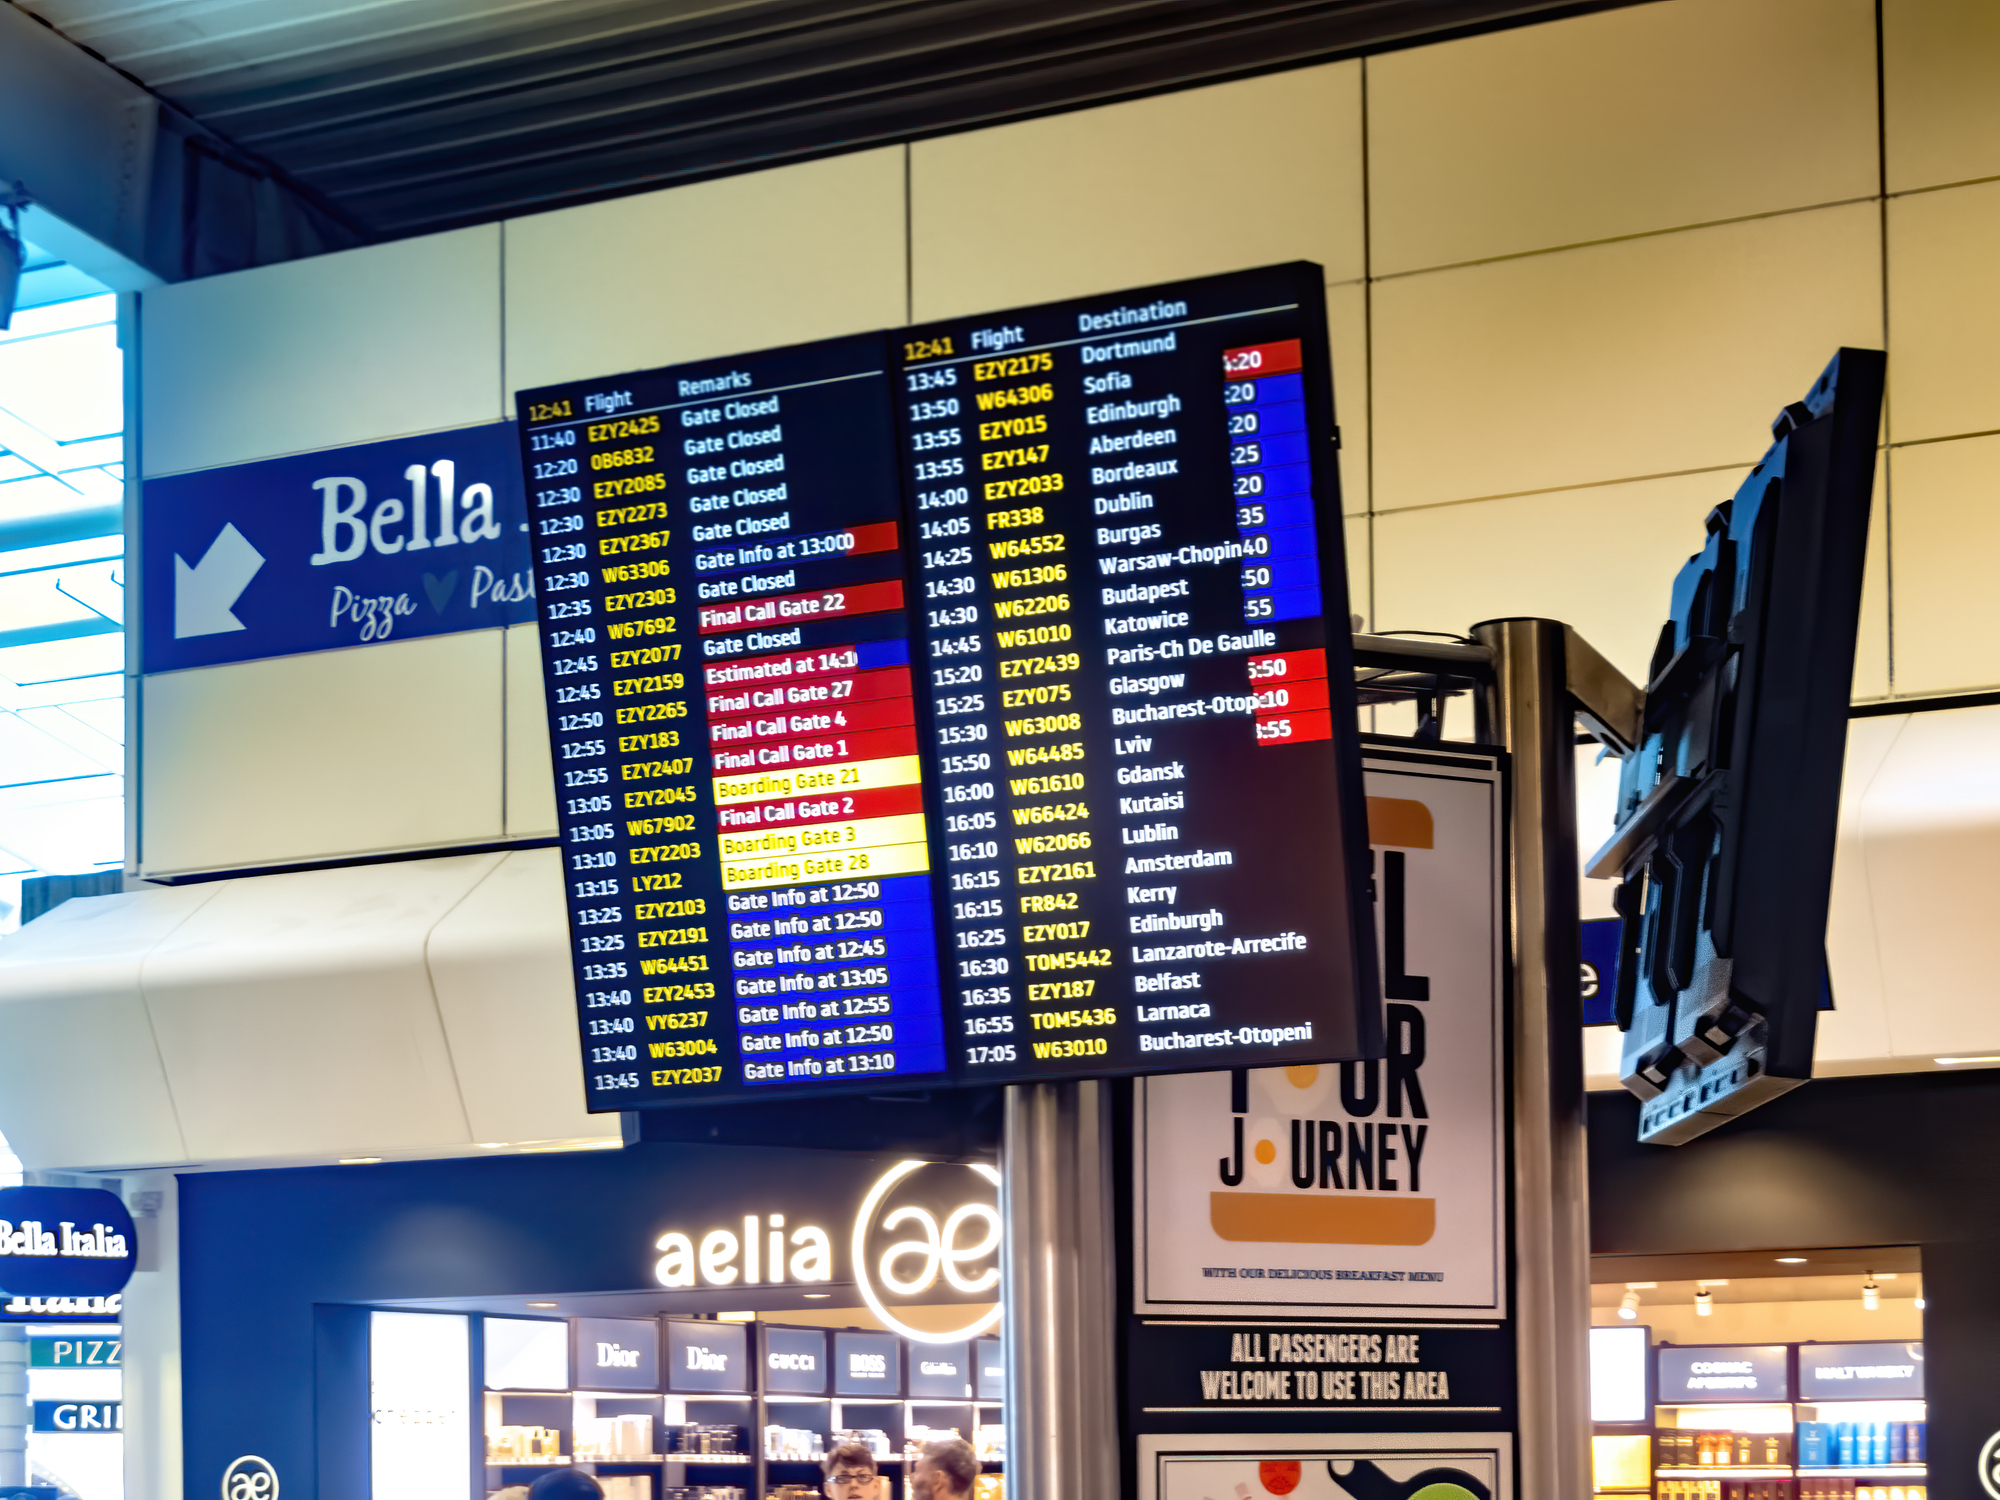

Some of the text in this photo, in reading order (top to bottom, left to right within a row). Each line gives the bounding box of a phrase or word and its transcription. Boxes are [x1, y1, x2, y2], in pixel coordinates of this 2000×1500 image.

[904, 300, 1188, 360] 12:41 Flight Destination
[907, 331, 1176, 392] 13:45 EZY2175 Dortmund
[528, 371, 752, 422] 12:41 Flight Remarks
[531, 395, 780, 451] 11:40 EZY2425 Gate Closed
[912, 393, 1181, 451] 13:55 EZY015 Edinburgh
[536, 453, 785, 508] 12:30 EZY2085 Gate Closed
[917, 459, 1178, 510] 14:00 EZY2033 Bordeaux
[310, 459, 501, 566] Bella
[541, 511, 790, 564] 12:30 EZY2367 Gate Closed
[922, 523, 1162, 569] 14:25 W64552 Burgas
[329, 585, 418, 641] Pizza
[547, 569, 796, 620] 12:35 EZY2303 Gate Closed
[928, 579, 1190, 628] 14:30 W62206 Budapest
[550, 593, 846, 648] 12:40 W67692 Final Call Gate 22
[553, 627, 802, 676] 12:45 EZY2077 Gate Closed
[933, 628, 1276, 687] 15:20 EZY2439 Paris-Ch De Gaulle
[558, 679, 853, 732] 12:50 EZY2265 Final Call Gate 27
[935, 673, 1185, 716] 15:25 EZY075 Glasgow
[563, 739, 849, 787] 12:55 EZY2407 Final Call Gate 1
[943, 761, 1185, 803] 16:00 W61610 Gdansk
[566, 768, 860, 815] 13:05 EZY2045 Boarding Gate 21
[945, 790, 1185, 833] 16:05 W66424 Kutaisi
[572, 826, 855, 870] 13:10 EZY2203 Boarding Gate 3
[948, 822, 1179, 862] 16:10 W62066 Lublin
[951, 849, 1233, 891] 16:15 EZY2161 Amsterdam
[577, 881, 880, 926] 13:25 EZY2103 Gate Info at 12:50
[953, 886, 1177, 920] 16:15 FR842 Kerry
[956, 908, 1224, 949] 16:25 EZY017 Edinburgh
[959, 957, 1009, 978] 16:30
[1132, 931, 1307, 963] Lanzarote-Arrecife
[961, 971, 1202, 1007] 16:35 EZY187 Belfast
[589, 995, 890, 1036] 13:40 VY6237 Gate Info at 12:55
[964, 1015, 1014, 1035] 16:55
[1137, 1003, 1211, 1023] Larnaca
[966, 1021, 1313, 1064] 17:05 W63010 Bucharest-Otopeni
[59, 1221, 128, 1257] Italia
[655, 1214, 831, 1288] aelia
[596, 1342, 641, 1368] Dior
[686, 1345, 728, 1371] Dior
[768, 1352, 815, 1371] GUCCI
[1231, 1333, 1420, 1364] ALL PASSENGERS ARE
[1200, 1370, 1450, 1400] WELCOME TO USE THIS AREA
